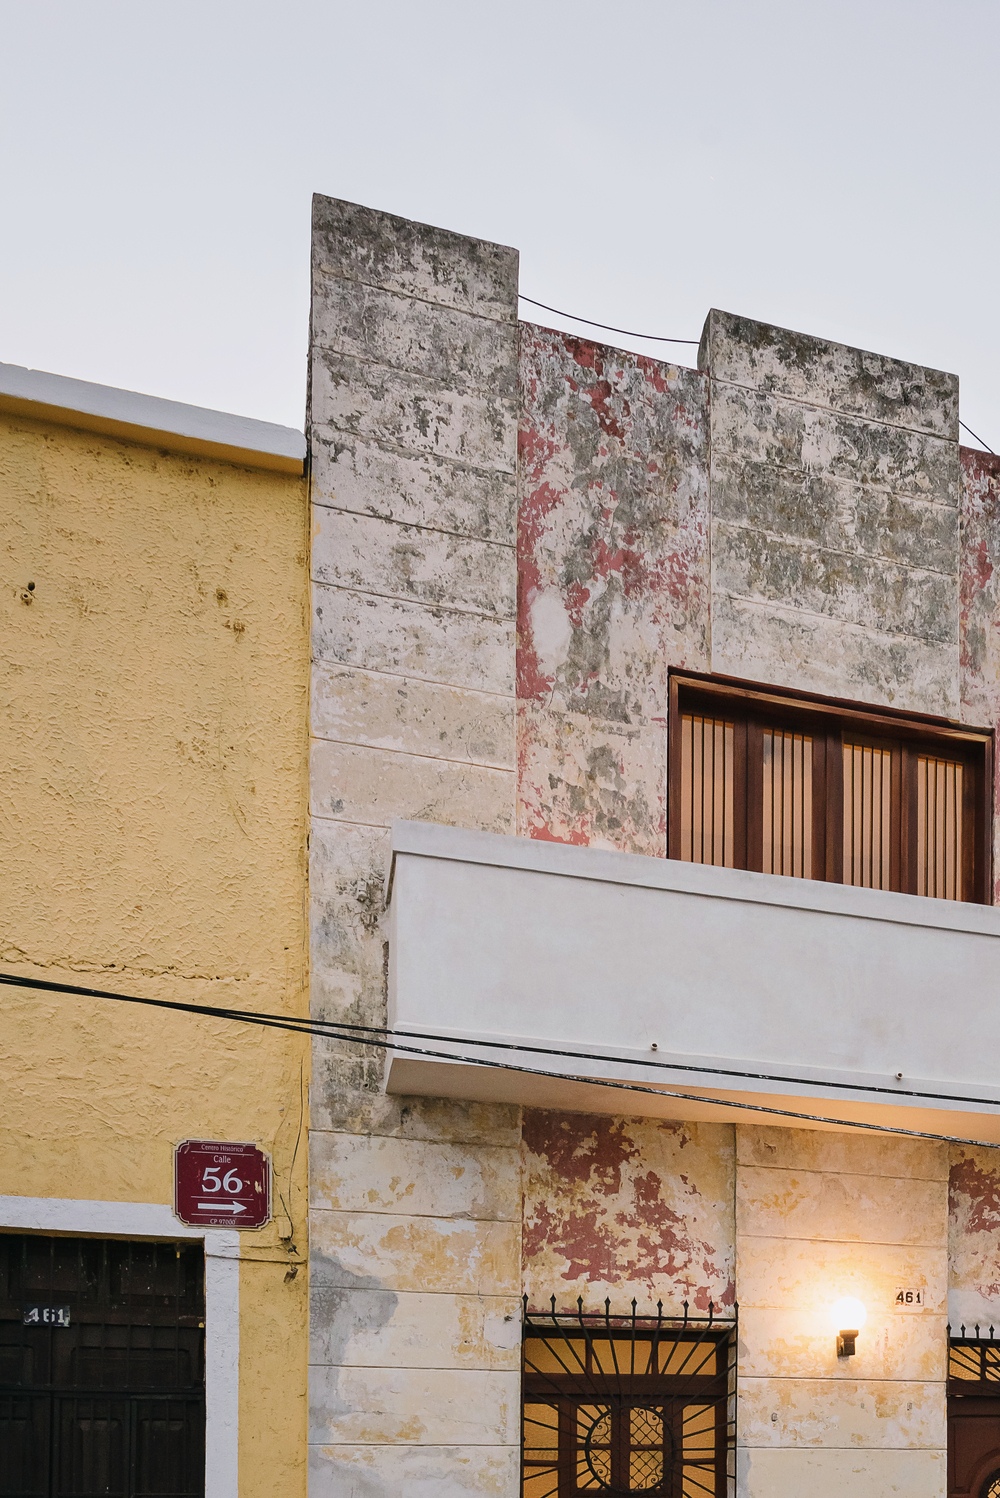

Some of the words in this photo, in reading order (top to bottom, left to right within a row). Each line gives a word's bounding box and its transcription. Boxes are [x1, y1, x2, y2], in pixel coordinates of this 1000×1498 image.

[213, 1155, 232, 1164] Calle
[201, 1167, 243, 1194] 56
[895, 1290, 921, 1303] 461
